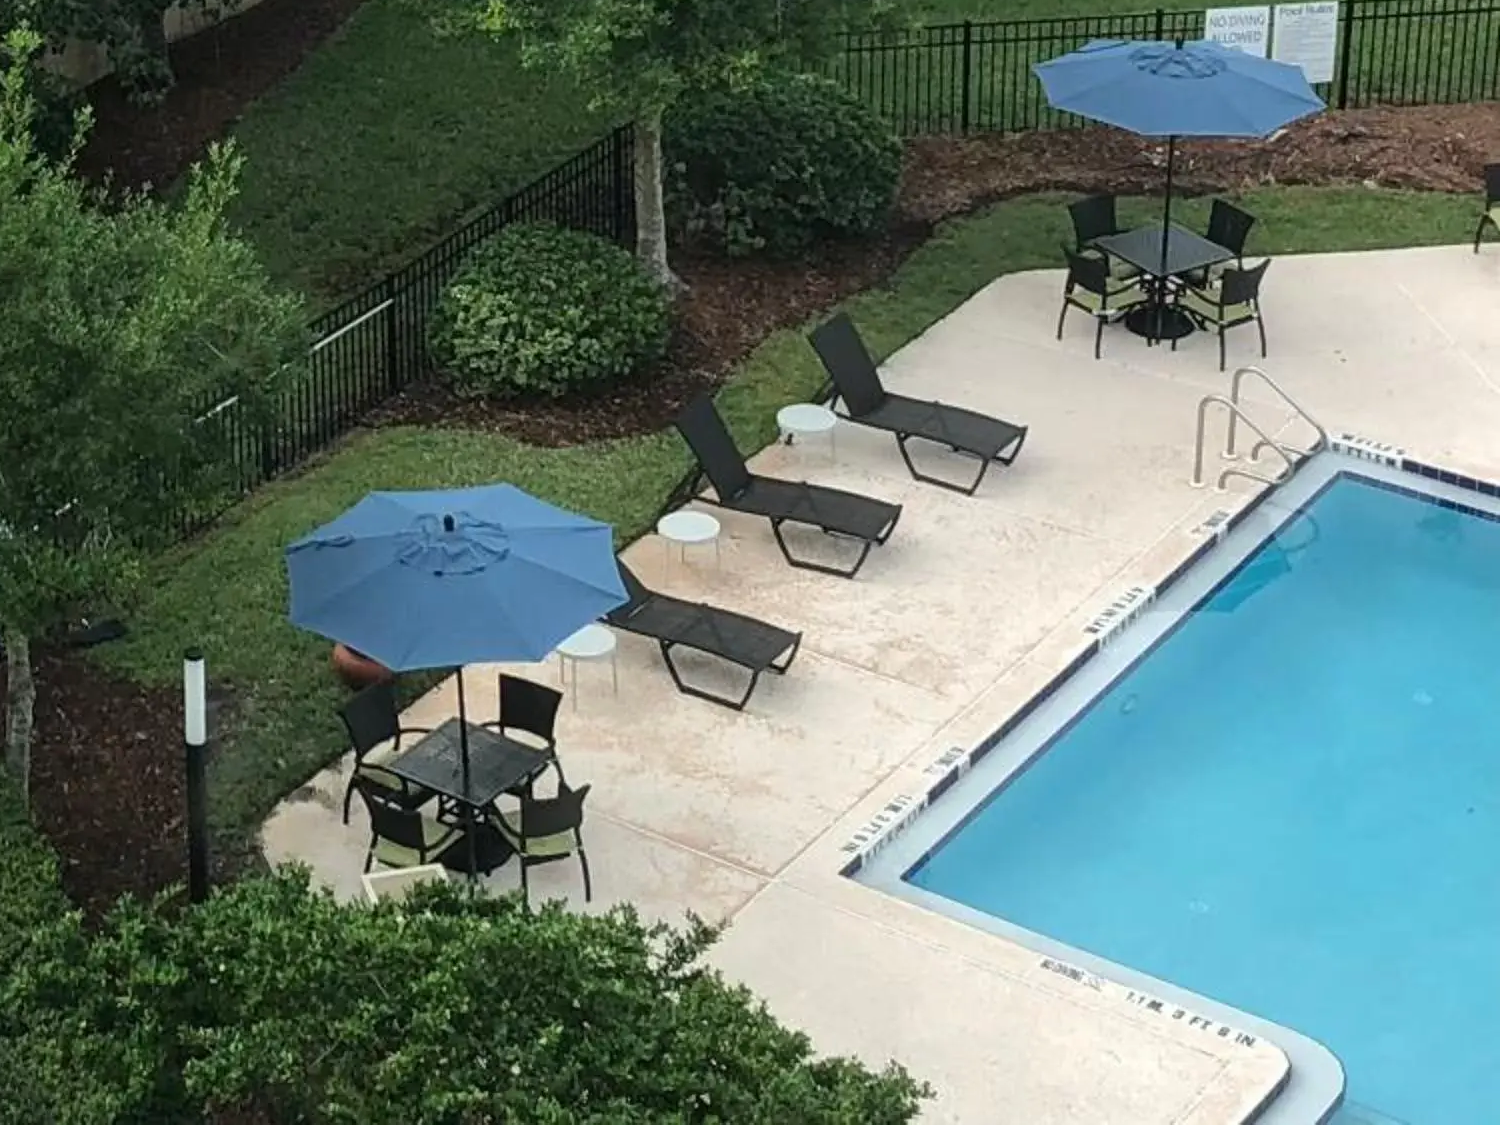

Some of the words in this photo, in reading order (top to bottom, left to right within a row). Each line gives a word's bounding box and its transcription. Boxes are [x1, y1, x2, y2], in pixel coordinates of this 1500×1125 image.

[1210, 16, 1227, 28] NO
[1228, 13, 1265, 27] DIVING
[1212, 30, 1262, 44] ALLOWED
[1236, 1033, 1256, 1047] IN
